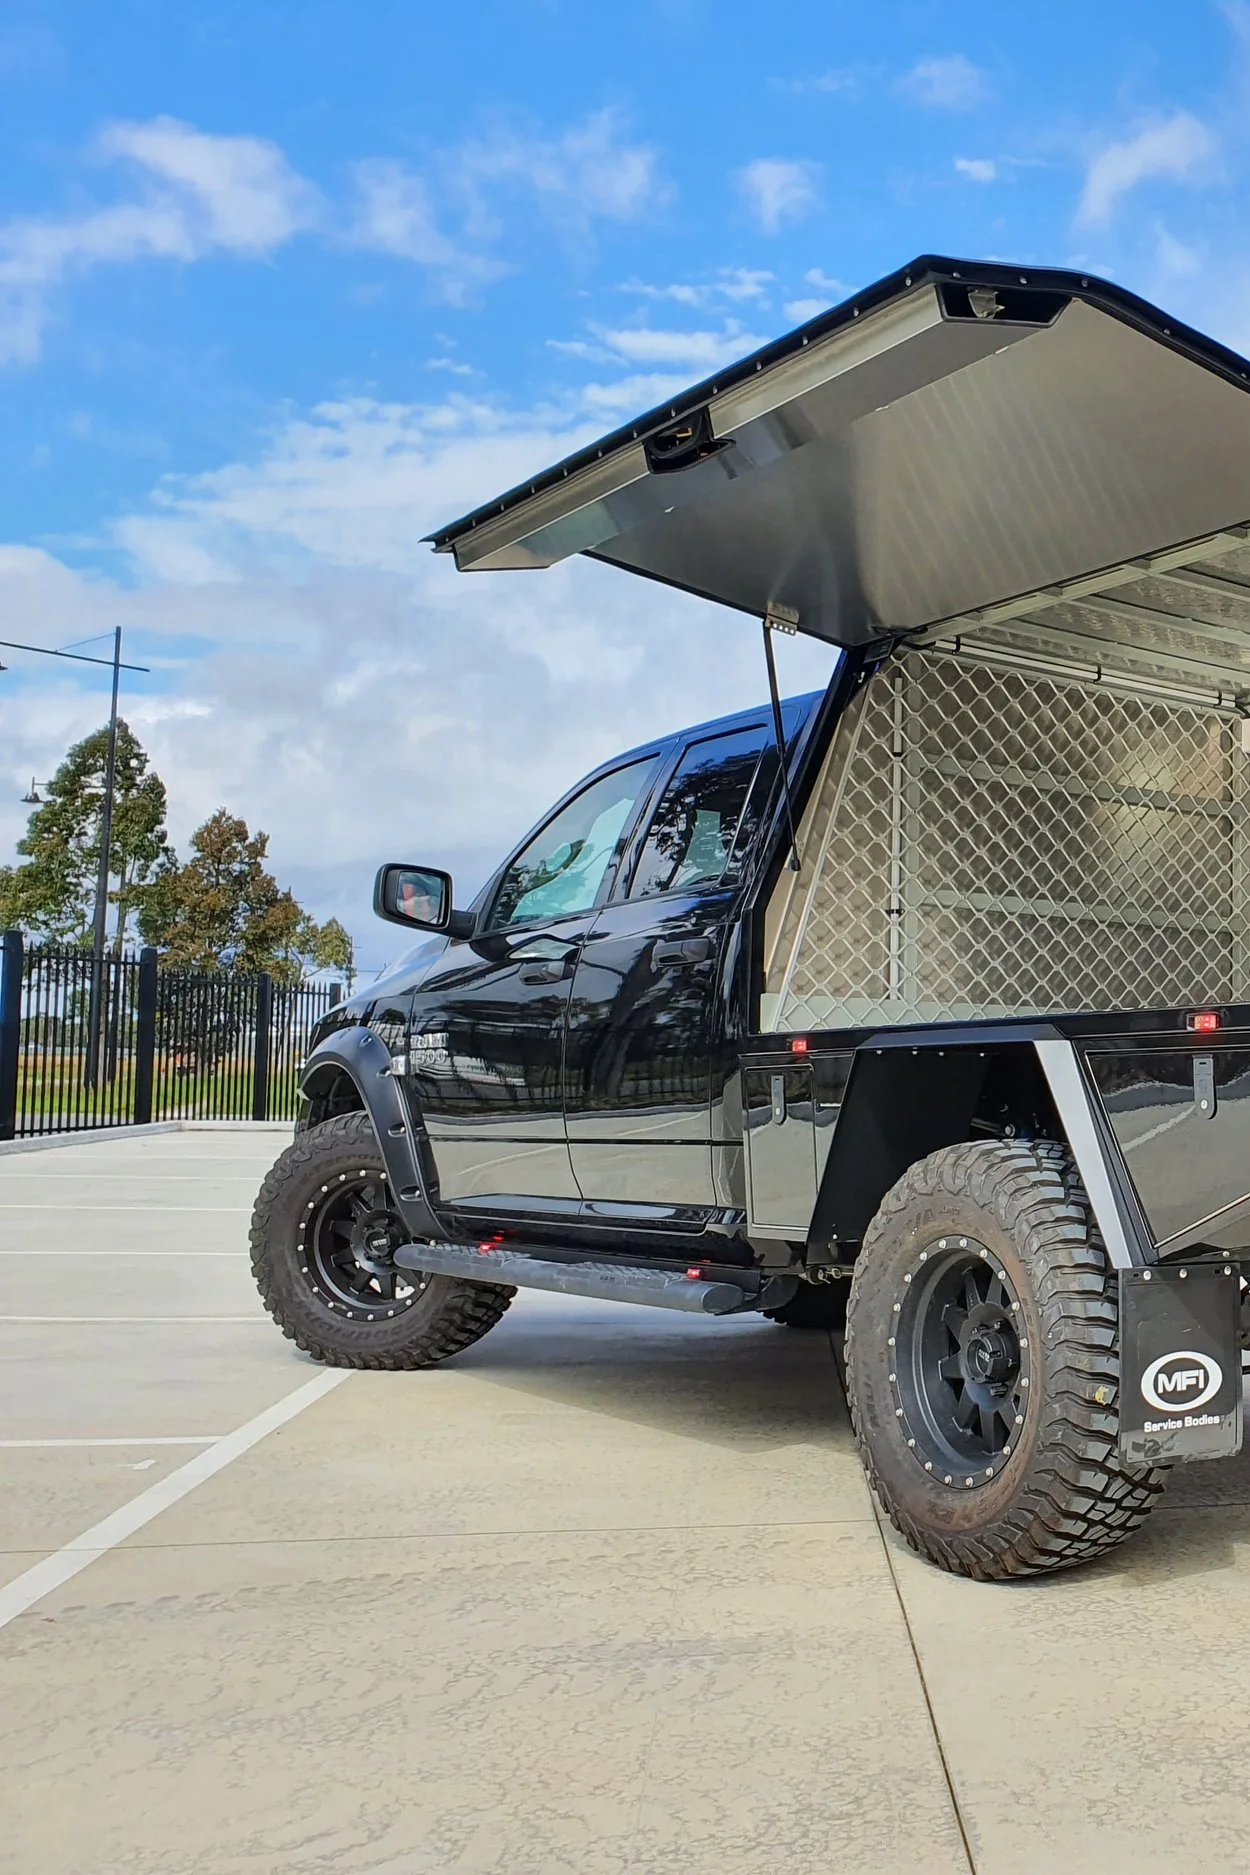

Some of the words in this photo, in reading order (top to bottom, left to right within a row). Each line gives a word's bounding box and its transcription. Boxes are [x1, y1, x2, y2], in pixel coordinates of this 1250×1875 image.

[409, 1049, 448, 1064] 1500
[1157, 1369, 1205, 1394] MFI
[1144, 1418, 1183, 1433] Service
[1184, 1414, 1220, 1427] Bodies
